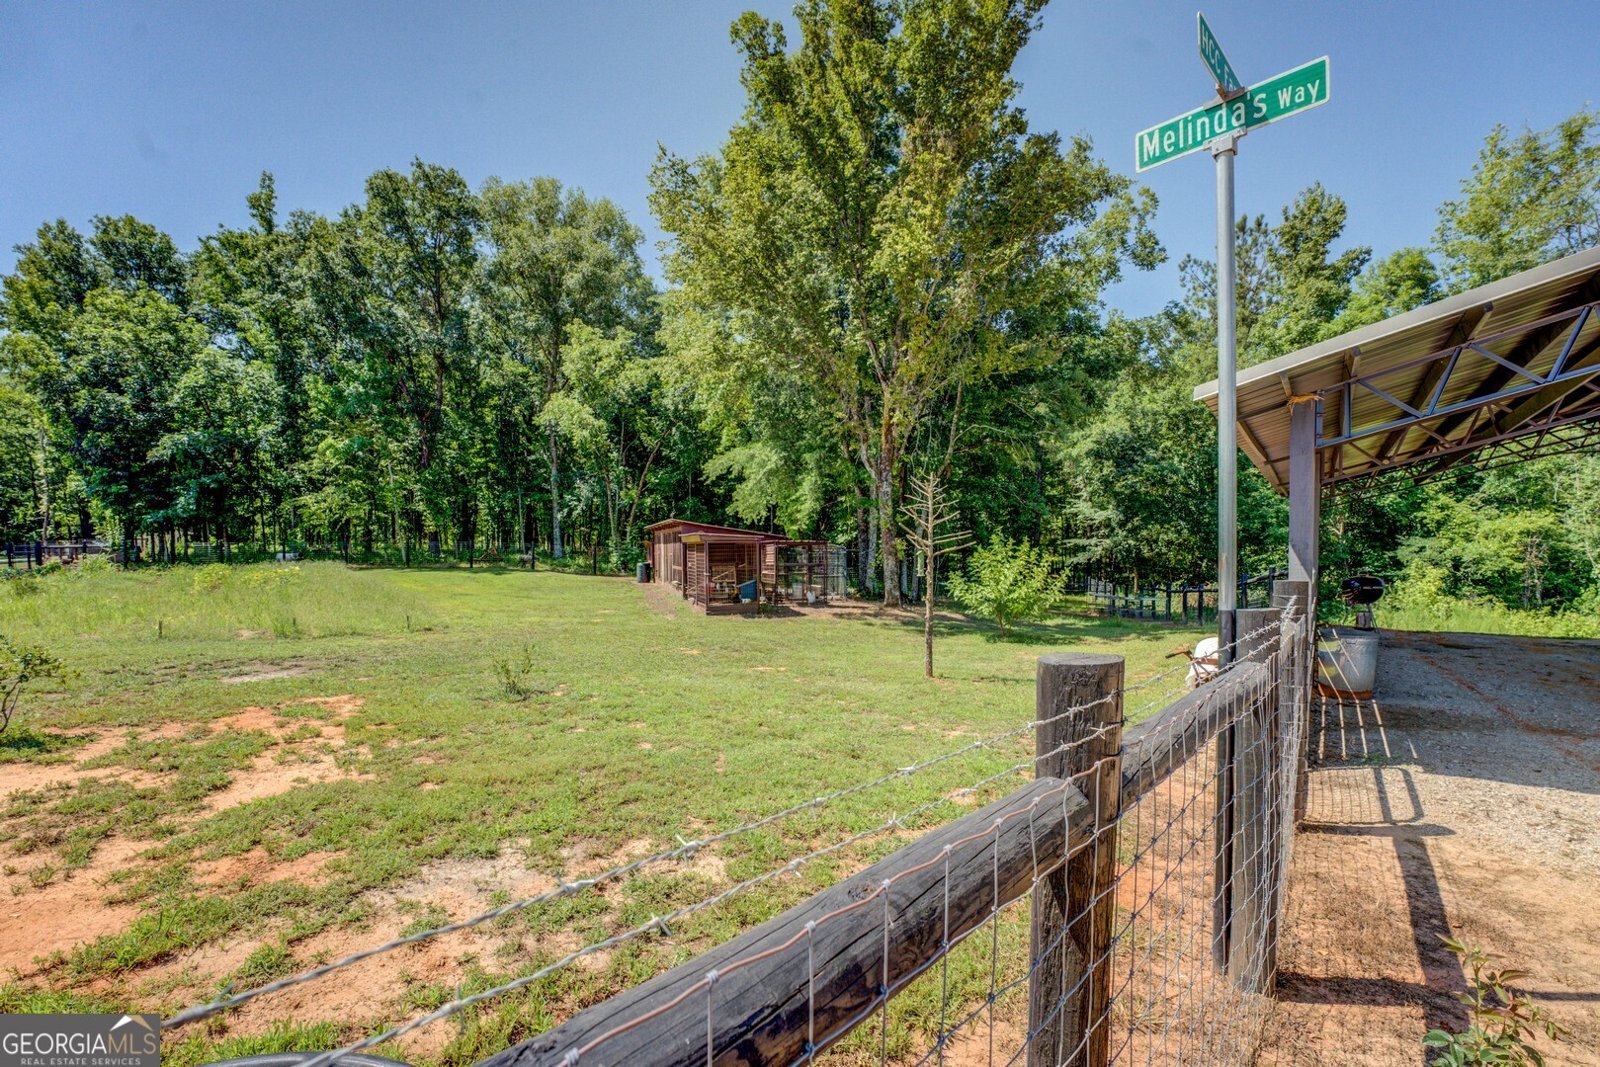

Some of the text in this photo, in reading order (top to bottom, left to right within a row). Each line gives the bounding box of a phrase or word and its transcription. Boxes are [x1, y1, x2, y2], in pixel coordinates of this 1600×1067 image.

[1201, 23, 1237, 92] HCC Fa
[1142, 79, 1320, 163] Melinda's Way
